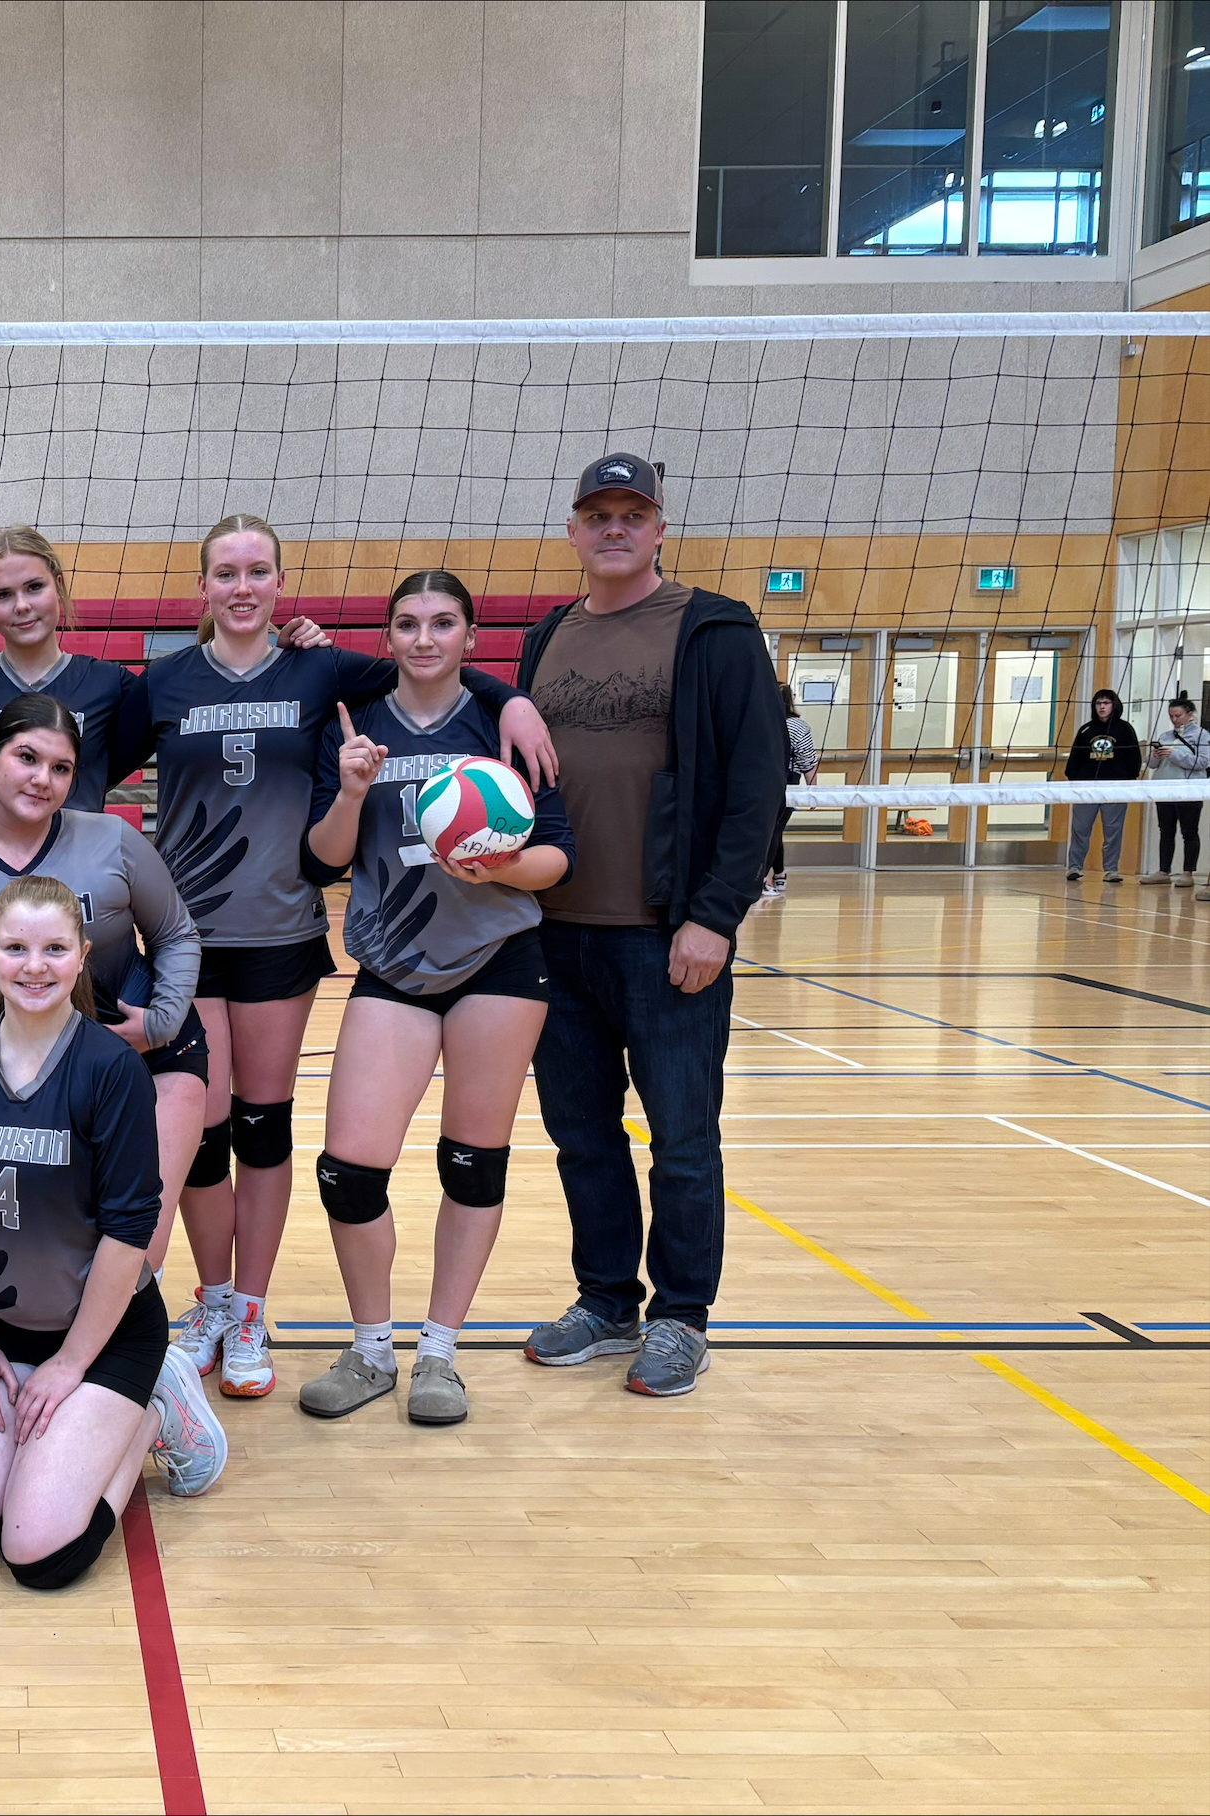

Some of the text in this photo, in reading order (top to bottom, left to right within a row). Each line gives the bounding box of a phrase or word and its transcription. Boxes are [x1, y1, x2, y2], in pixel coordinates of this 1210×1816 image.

[180, 701, 300, 735] JACKSON
[223, 733, 255, 786] 5
[370, 753, 471, 785] ACKS
[400, 784, 420, 837] 1
